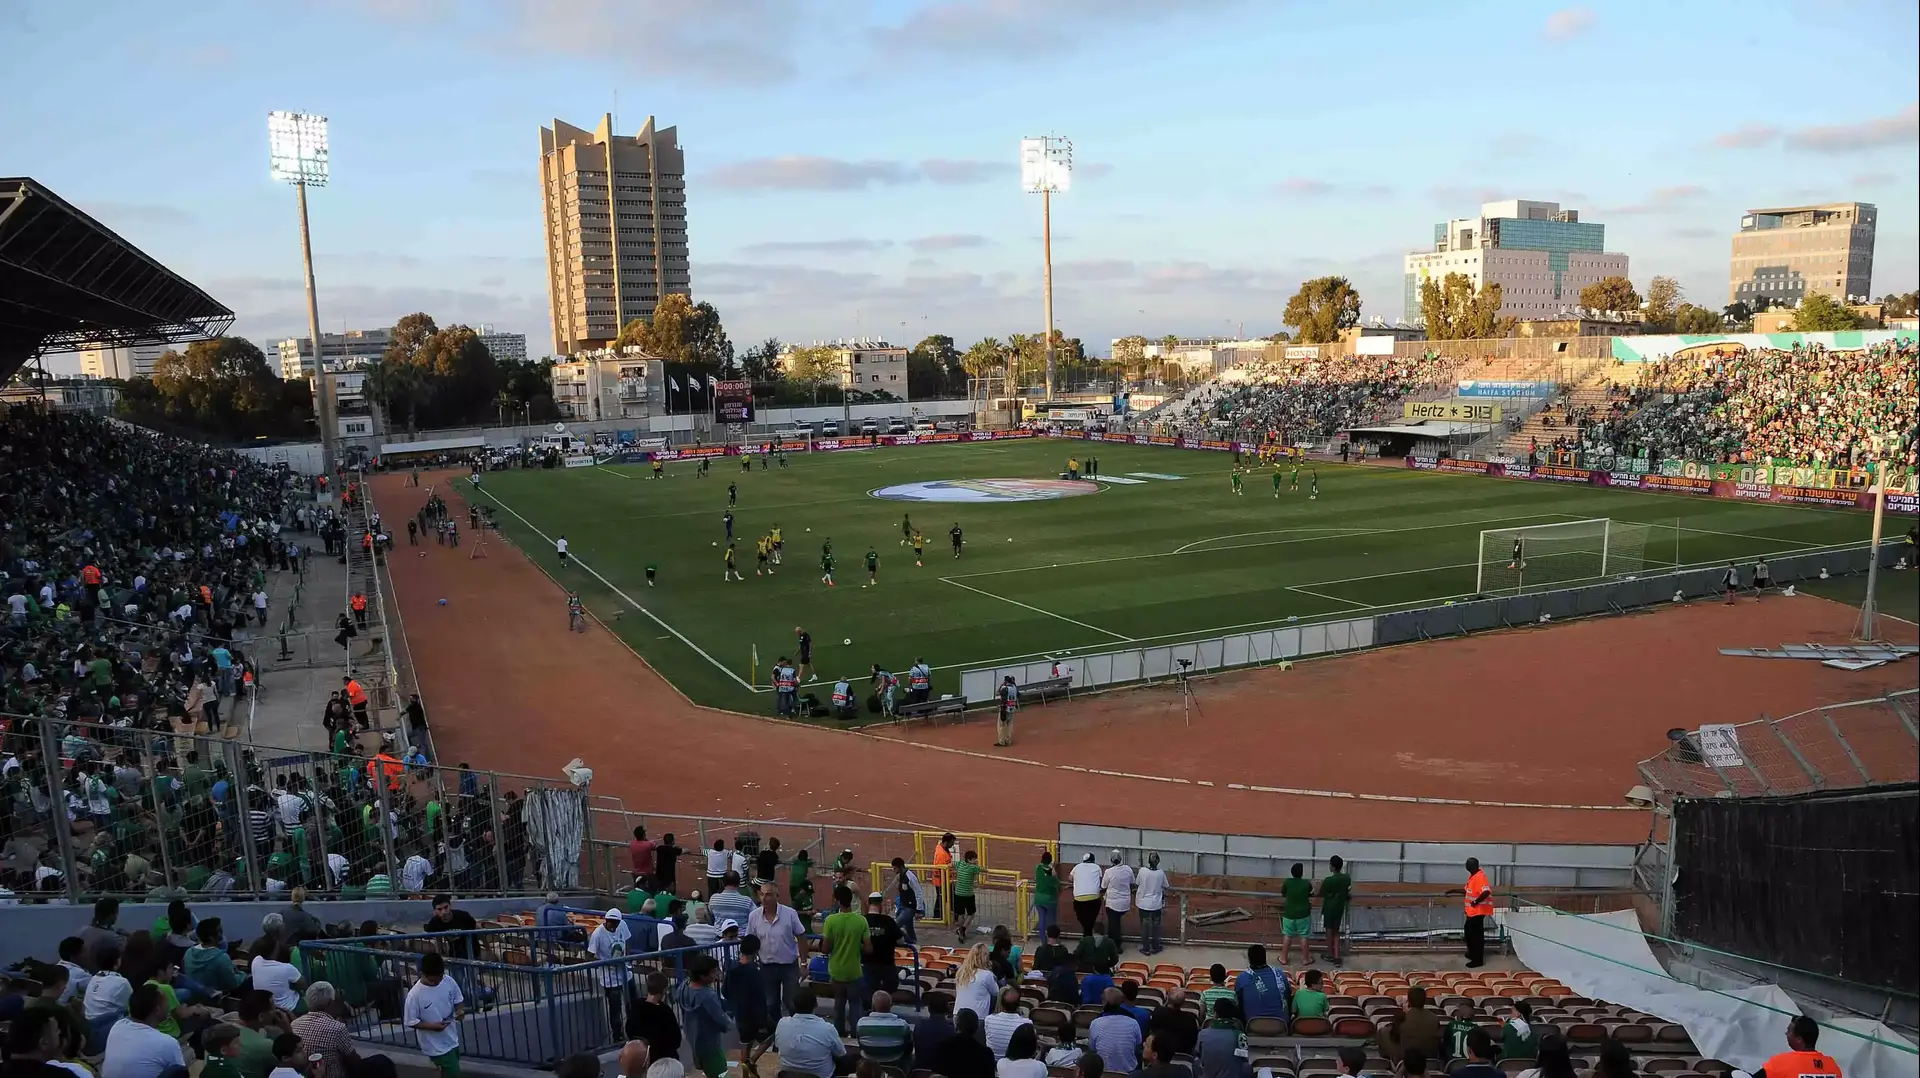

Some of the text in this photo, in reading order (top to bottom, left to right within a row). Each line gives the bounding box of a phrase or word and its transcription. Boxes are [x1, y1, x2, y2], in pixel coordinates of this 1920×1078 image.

[723, 382, 744, 390] 00:00
[1412, 403, 1445, 417] Hertz
[1534, 467, 1553, 475] דמארי
[1554, 468, 1575, 476] שושנה
[1684, 461, 1712, 480] GA
[1610, 472, 1641, 481] 15.5 חמישי
[1740, 467, 1768, 484] 02
[1610, 479, 1640, 487] אודיטוריום
[1645, 475, 1711, 488] שירי שושנה דמארי
[1758, 484, 1772, 492] 15.5
[1736, 489, 1771, 499] אודיטוריום
[1778, 487, 1857, 501] שירי שושנה דמארי
[1888, 494, 1914, 503] חמישי
